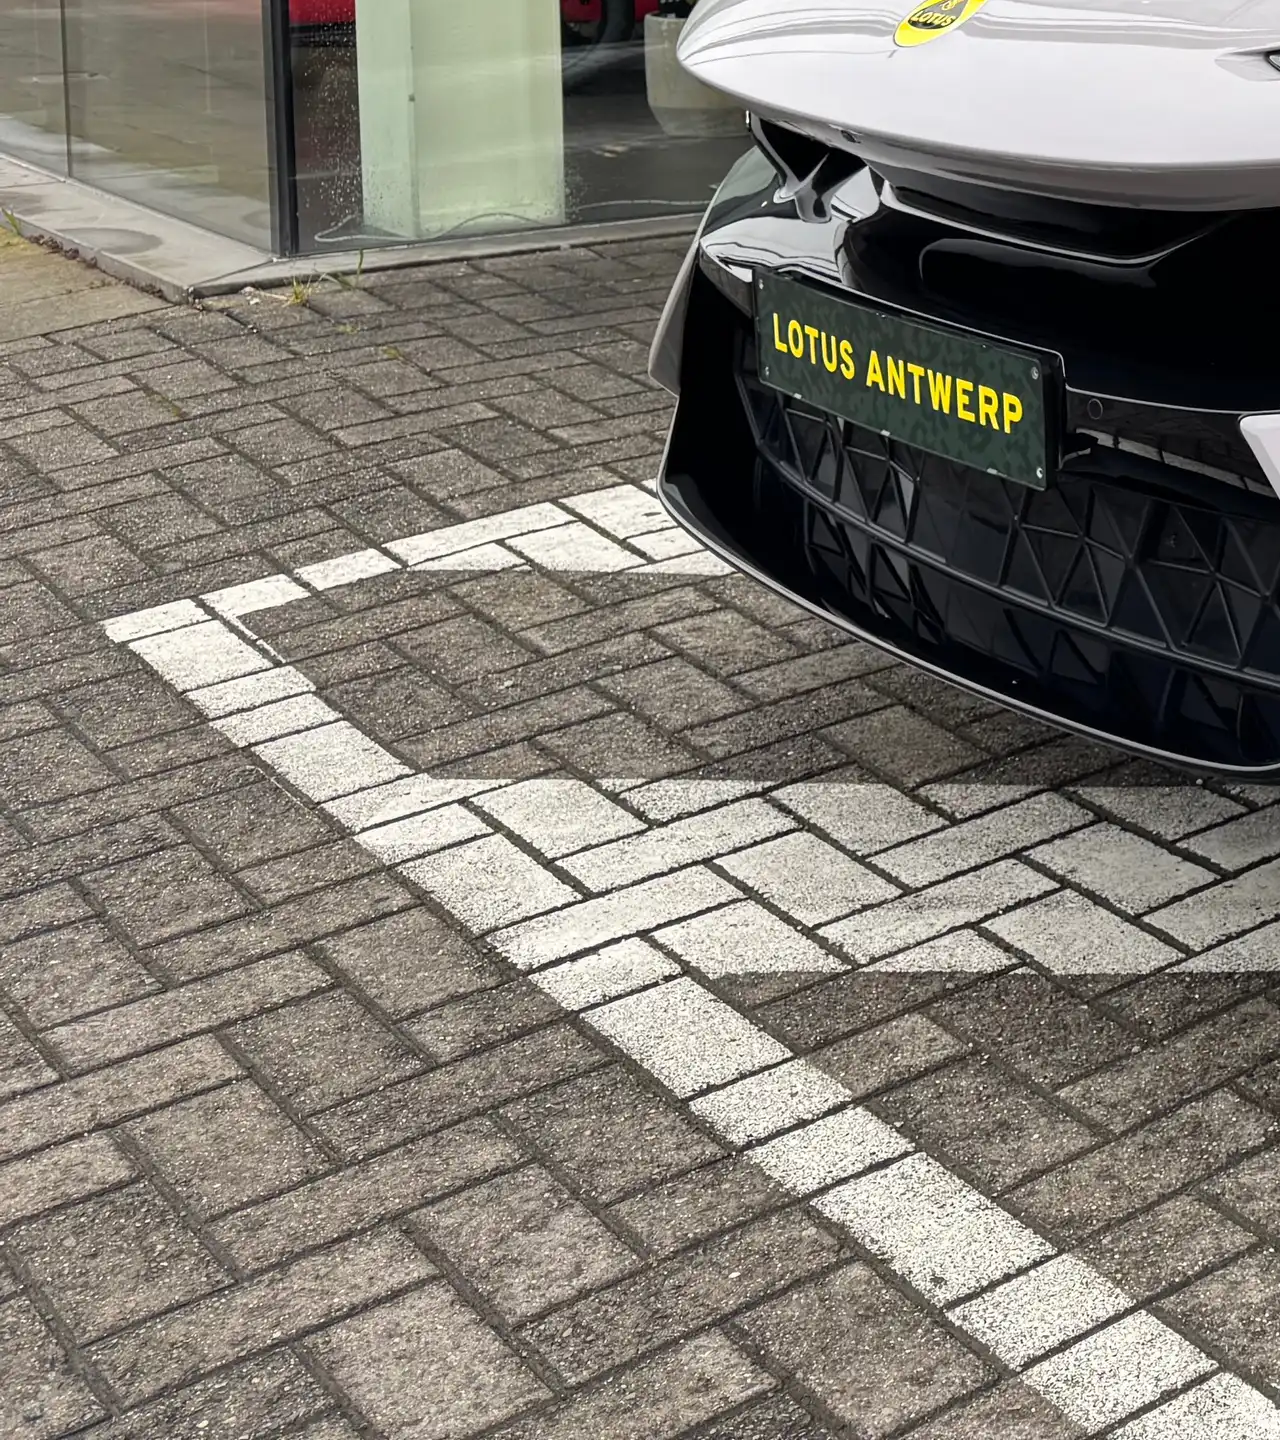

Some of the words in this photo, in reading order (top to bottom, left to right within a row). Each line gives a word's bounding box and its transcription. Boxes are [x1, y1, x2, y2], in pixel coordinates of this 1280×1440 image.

[910, 11, 957, 27] LOTUS
[772, 312, 856, 380] LOTUS
[866, 350, 1024, 435] ANTWERP
